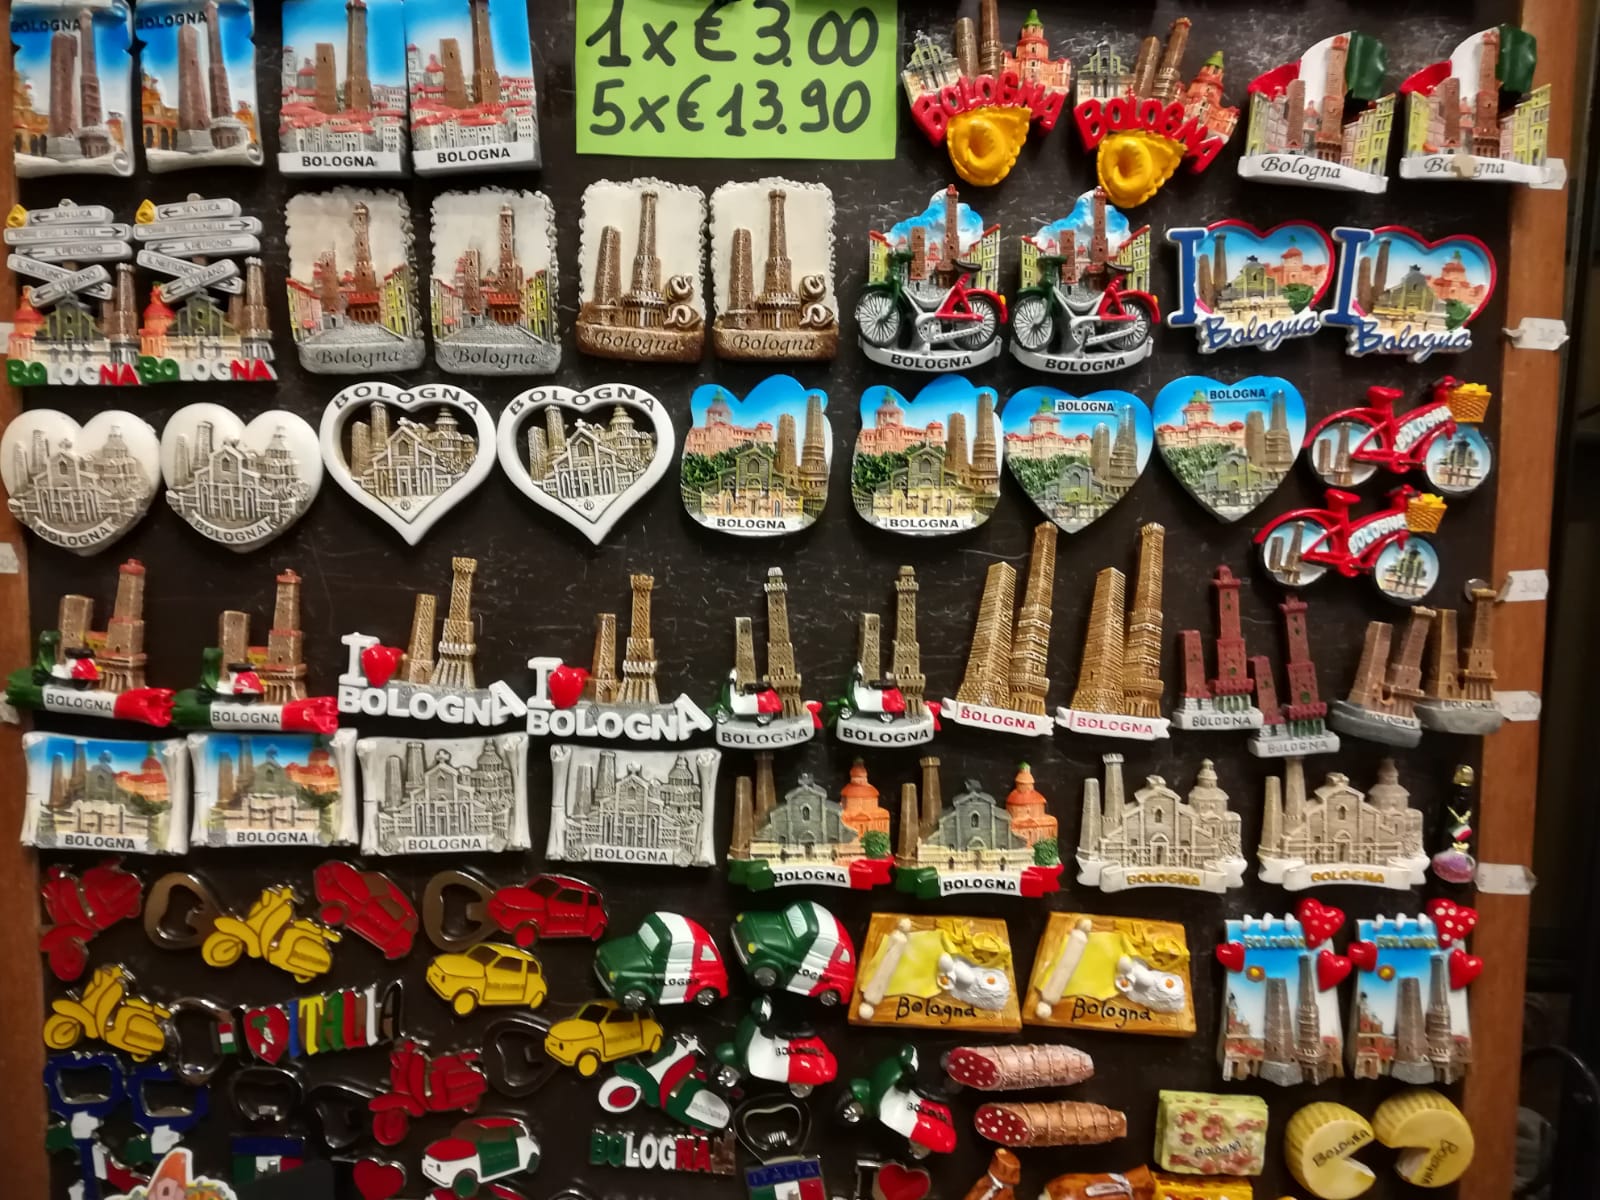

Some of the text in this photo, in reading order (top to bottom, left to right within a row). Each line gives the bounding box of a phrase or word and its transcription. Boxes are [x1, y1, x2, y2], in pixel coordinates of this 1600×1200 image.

[9, 17, 82, 34] BOLOGNA
[135, 11, 208, 30] BOLOGNA
[912, 72, 1066, 147] BOLOGNA
[1073, 86, 1225, 174] BOLOGNA
[302, 155, 375, 168] BOLOGNA
[437, 147, 511, 164] BOLOGNA
[1260, 156, 1342, 181] Bologna
[1169, 229, 1207, 326] I
[1334, 228, 1371, 325] I
[1204, 310, 1320, 350] Bologna
[595, 331, 680, 357] Bologna
[732, 332, 816, 356] Bologna
[1358, 327, 1472, 358] Bologna
[139, 355, 272, 382] BOLOGNA
[316, 348, 402, 372] Bologna
[455, 348, 537, 370] Bologna
[890, 353, 973, 370] BOLOGNA
[1045, 355, 1126, 373] BOLOGNA
[7, 359, 139, 386] BOLOGNA
[334, 384, 480, 416] BOLOGNA
[508, 385, 656, 417] BOLOGNA
[1209, 388, 1267, 401] BOLOGNA
[1057, 400, 1116, 413] BOLOGNA
[1394, 405, 1452, 453] BOLOGNA
[193, 521, 268, 543] BOLOGNA
[716, 518, 787, 530] BOLOGNA
[889, 517, 960, 530] BOLOGNA
[38, 525, 111, 547] BOLOGNA
[1348, 513, 1408, 557] BOLOGNA
[340, 632, 379, 687] I
[527, 657, 563, 710] I
[46, 692, 113, 711] BOLOGNA
[338, 680, 528, 727] BOLOGNA
[212, 710, 280, 726] BOLOGNA
[527, 693, 713, 741] BOLOGNA
[960, 707, 1037, 731] BOLOGNA
[1076, 716, 1154, 737] BOLOGNA
[1191, 713, 1252, 728] BOLOGNA
[721, 727, 808, 746] BOLOGNA
[842, 726, 929, 744] BOLOGNA
[1267, 738, 1329, 755] BOLOGNA
[64, 833, 136, 850] BOLOGNA
[236, 830, 309, 844] BOLOGNA
[408, 838, 482, 851] BOLOGNA
[594, 848, 669, 863] BOLOGNA
[774, 868, 847, 884] BOLOGNA
[943, 877, 1016, 893] BOLOGNA
[1126, 871, 1200, 888] BOLOGNA
[1310, 869, 1385, 884] BOLOGNA
[895, 996, 977, 1021] Bologna
[1071, 998, 1153, 1022] Bologna
[590, 1128, 712, 1172] BOLOGNA
[1312, 1129, 1369, 1168] BOLOGNA
[751, 1165, 816, 1184] ITALIA
